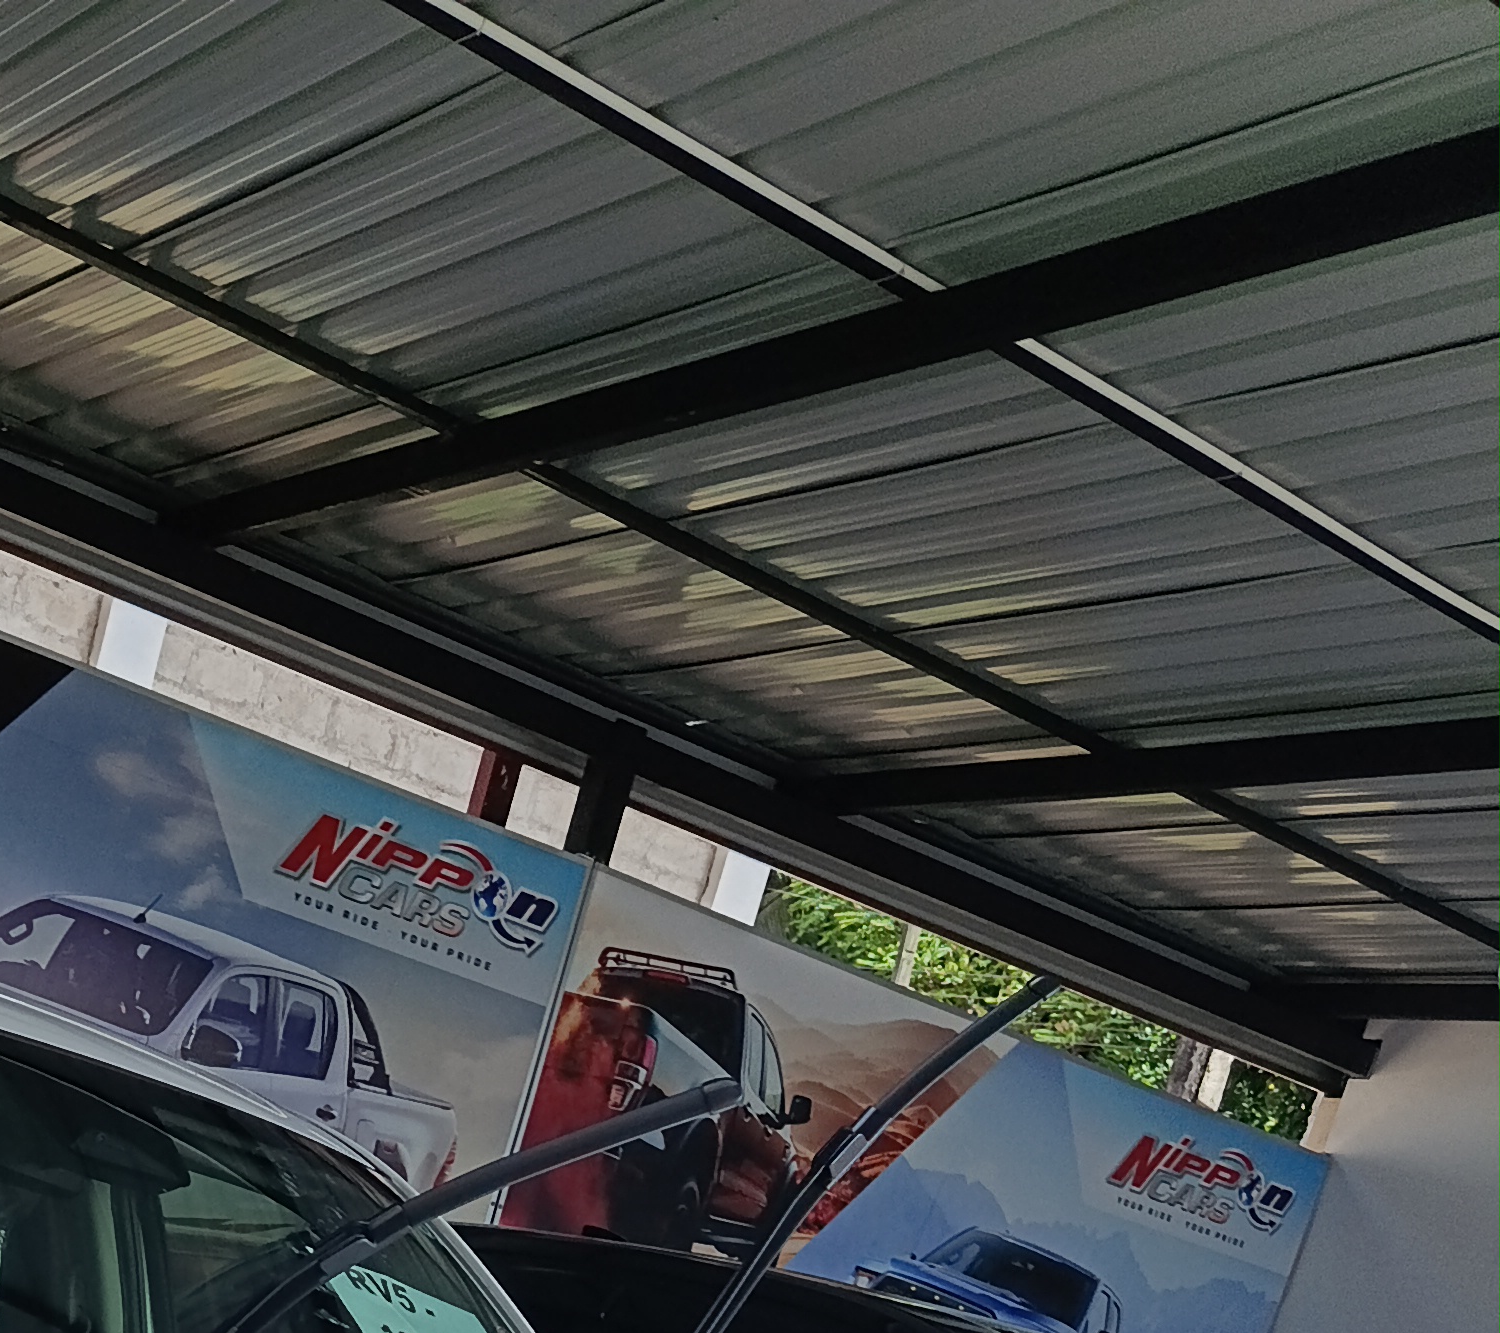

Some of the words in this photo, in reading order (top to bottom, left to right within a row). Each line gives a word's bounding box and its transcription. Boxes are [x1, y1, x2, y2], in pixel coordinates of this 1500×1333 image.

[294, 892, 334, 914] YOUR
[342, 909, 380, 931] RIDE
[400, 931, 440, 952] YOUR
[447, 947, 493, 972] PRIDE
[338, 866, 471, 938] CARS
[1147, 1170, 1235, 1225] CARS
[348, 1268, 417, 1314] RV5
